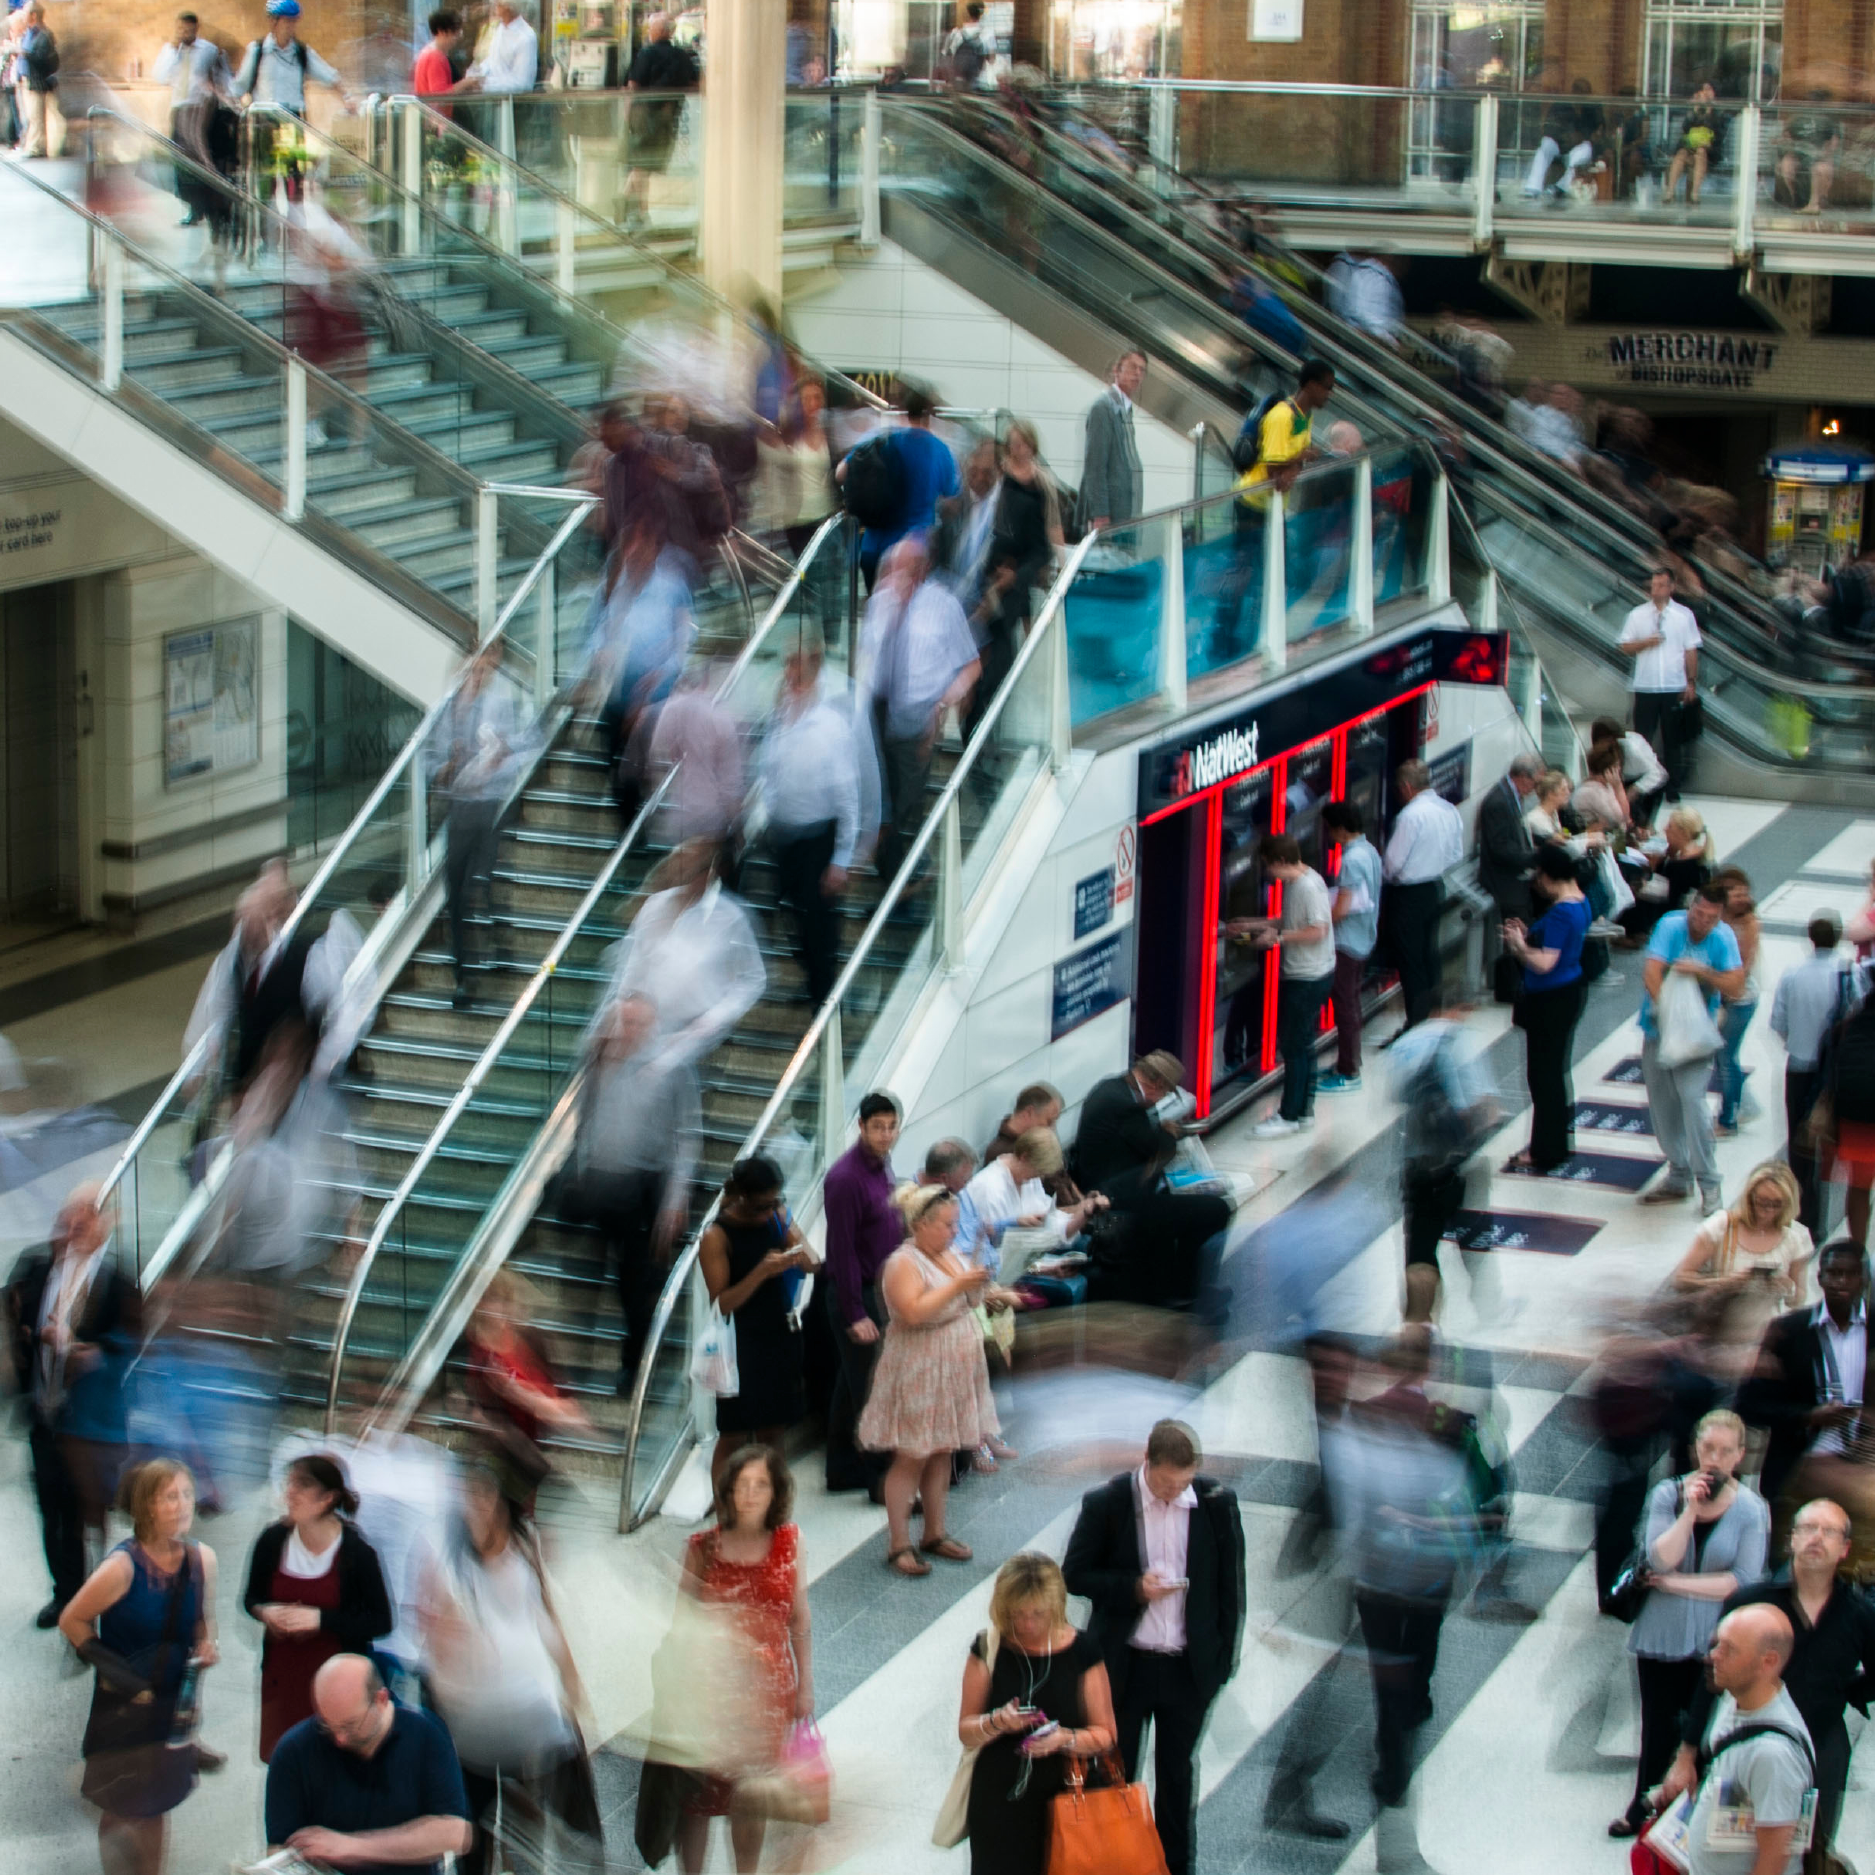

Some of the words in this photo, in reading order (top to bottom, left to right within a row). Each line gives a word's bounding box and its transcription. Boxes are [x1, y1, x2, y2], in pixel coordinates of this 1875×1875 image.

[1608, 332, 1779, 371] MERCHANT
[1631, 364, 1754, 387] BISHOPSGATE
[1195, 720, 1259, 791] NatWest
